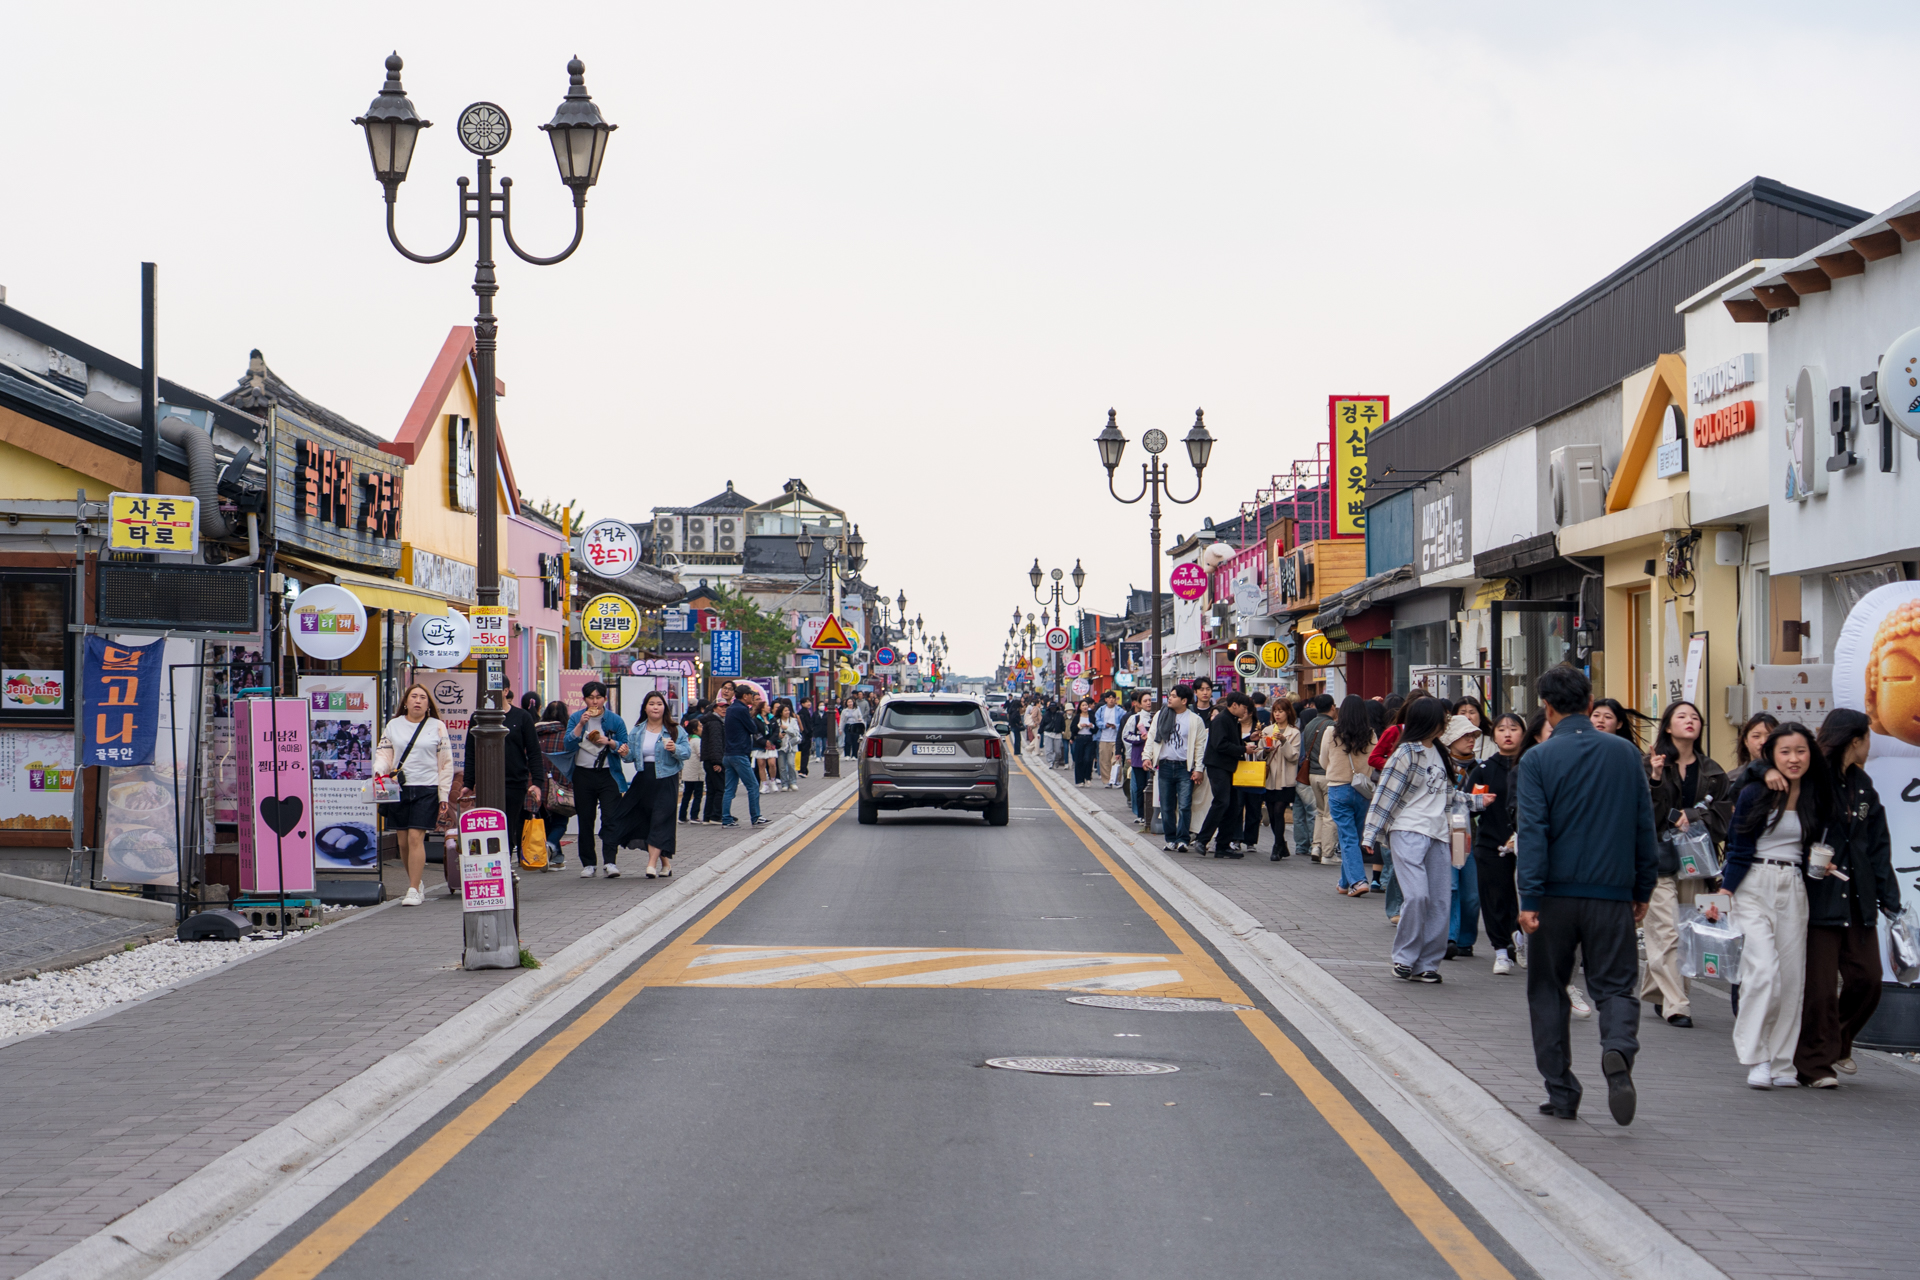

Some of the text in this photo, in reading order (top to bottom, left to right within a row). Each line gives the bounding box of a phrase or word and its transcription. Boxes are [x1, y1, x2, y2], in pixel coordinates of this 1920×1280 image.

[1693, 353, 1746, 402] PHOTOISM
[1342, 404, 1378, 424] 경주
[1694, 400, 1748, 448] COLORED
[304, 439, 353, 529] 꿀타래
[129, 500, 176, 520] 사주
[128, 526, 175, 545] 타로
[601, 527, 627, 542] 경주
[588, 543, 633, 566] 쫀드기
[1179, 567, 1199, 578] 구슬
[599, 603, 621, 615] 경주
[303, 615, 352, 631] 꿀타래
[476, 616, 502, 629] 한달
[589, 617, 631, 631] 십원빵
[473, 633, 506, 646] -5kg
[601, 632, 620, 644] 본점
[1051, 634, 1064, 645] 30
[1273, 647, 1285, 663] 10
[5, 684, 61, 697] JellyKing
[96, 646, 145, 744] 달고나
[314, 695, 361, 709] 꿀타래
[277, 730, 297, 742] 남친
[95, 748, 134, 761] 골목안
[277, 743, 303, 753] (속마음)
[467, 816, 499, 830] 교차로
[469, 884, 500, 898] 교차로
[473, 898, 504, 906] 745-1236
